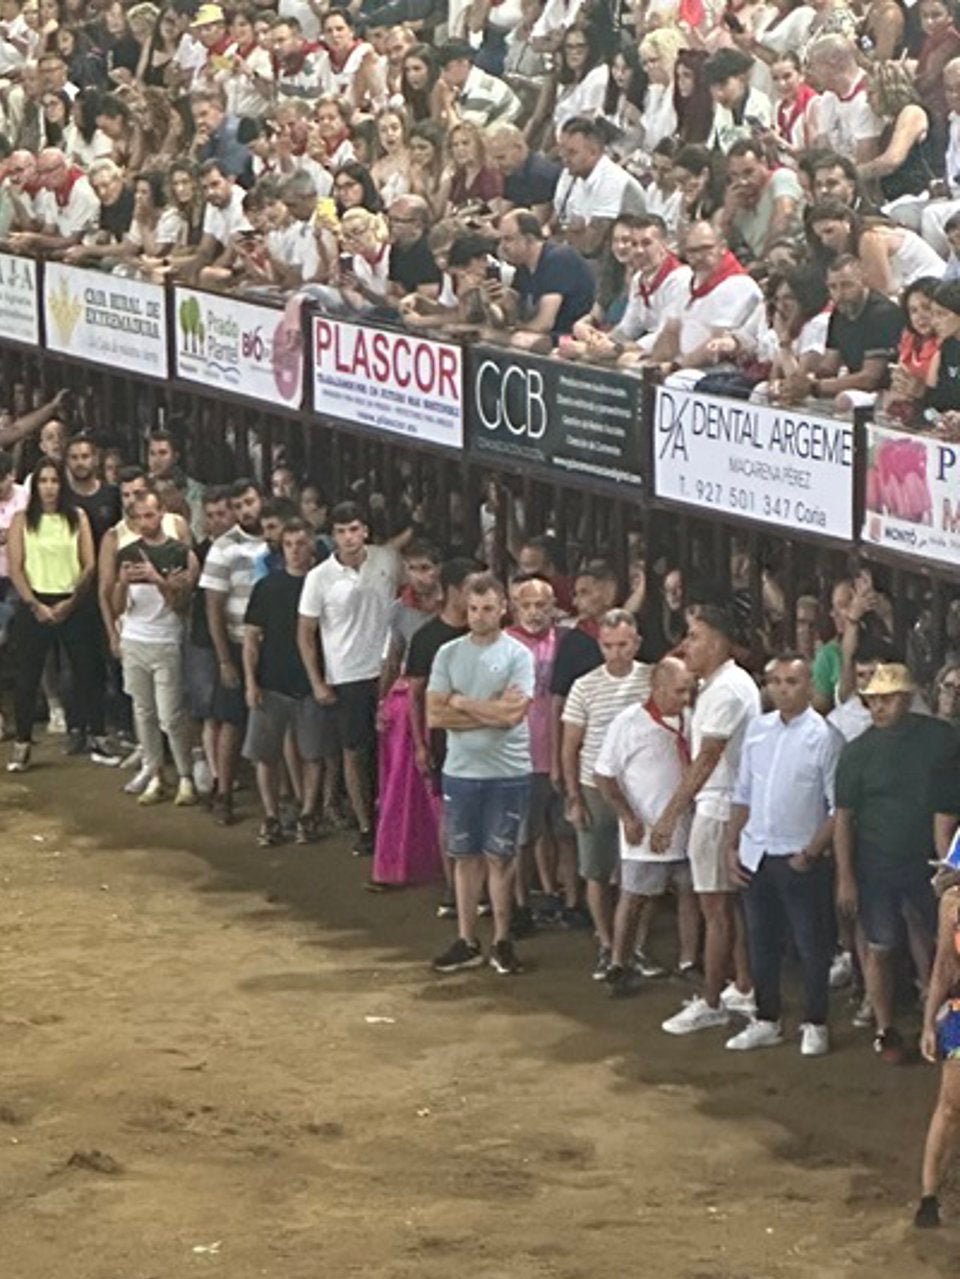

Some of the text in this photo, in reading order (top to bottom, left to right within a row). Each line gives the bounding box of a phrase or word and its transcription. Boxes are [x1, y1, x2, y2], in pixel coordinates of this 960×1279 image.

[316, 319, 459, 400] PLASCOR
[693, 401, 763, 450] DENTAL
[770, 417, 853, 467] ARGEME
[696, 479, 722, 504] 927
[730, 487, 755, 511] 501
[763, 495, 791, 519] 347
[793, 500, 827, 527] Coria
